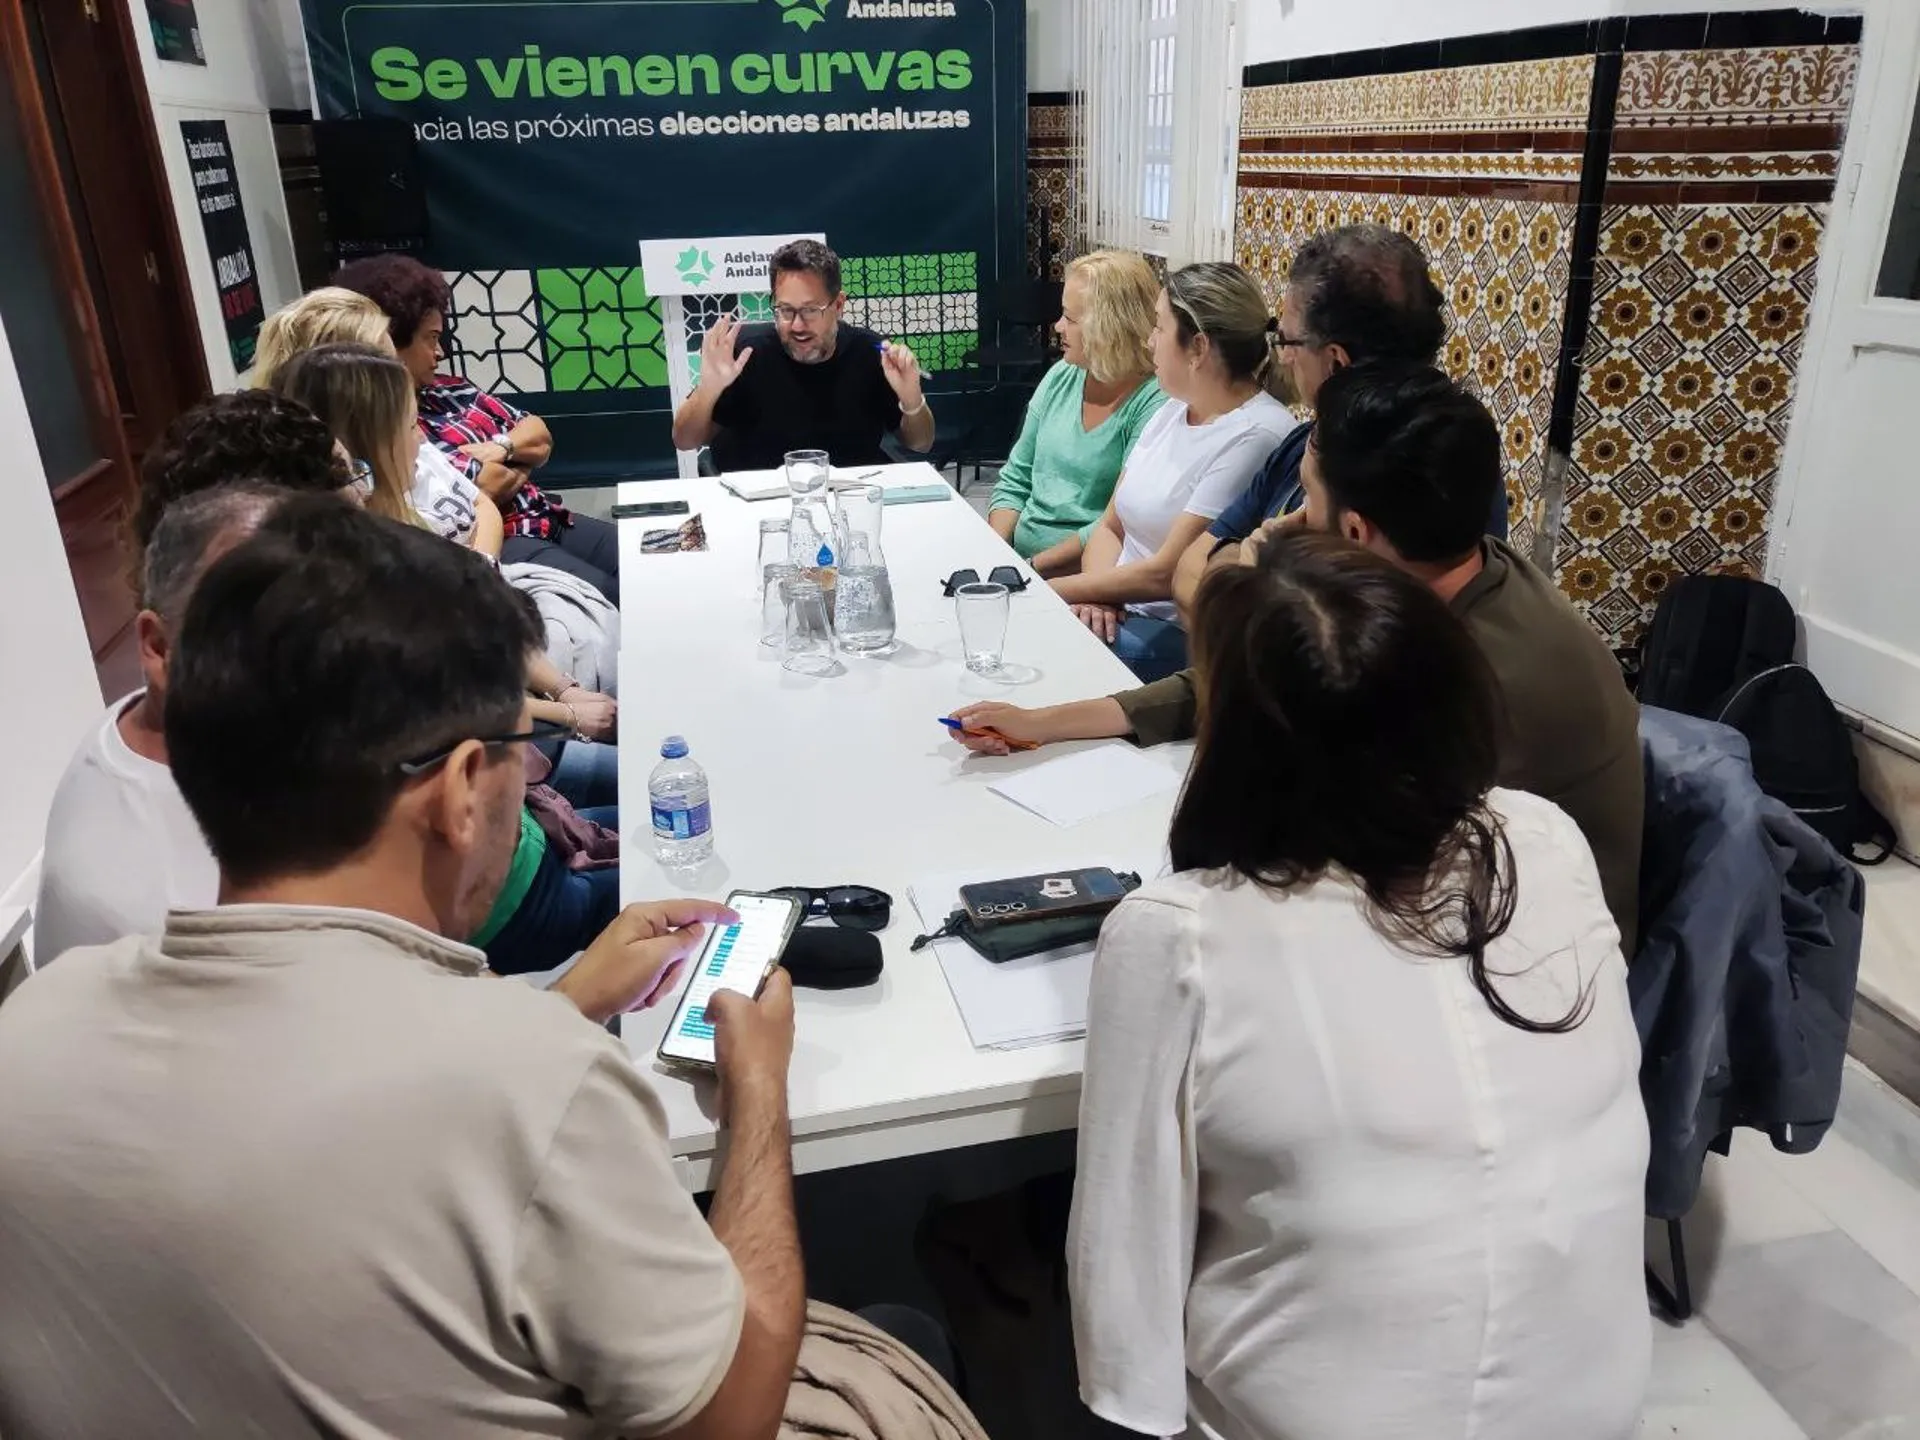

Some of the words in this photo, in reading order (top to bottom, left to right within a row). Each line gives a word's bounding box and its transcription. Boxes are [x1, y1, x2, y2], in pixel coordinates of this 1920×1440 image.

[371, 46, 468, 101] Se
[476, 44, 721, 98] vienen
[730, 49, 973, 94] curvas
[468, 115, 509, 140] las
[515, 112, 654, 143] próximas
[659, 110, 820, 135] elecciones
[824, 107, 970, 132] andaluzas
